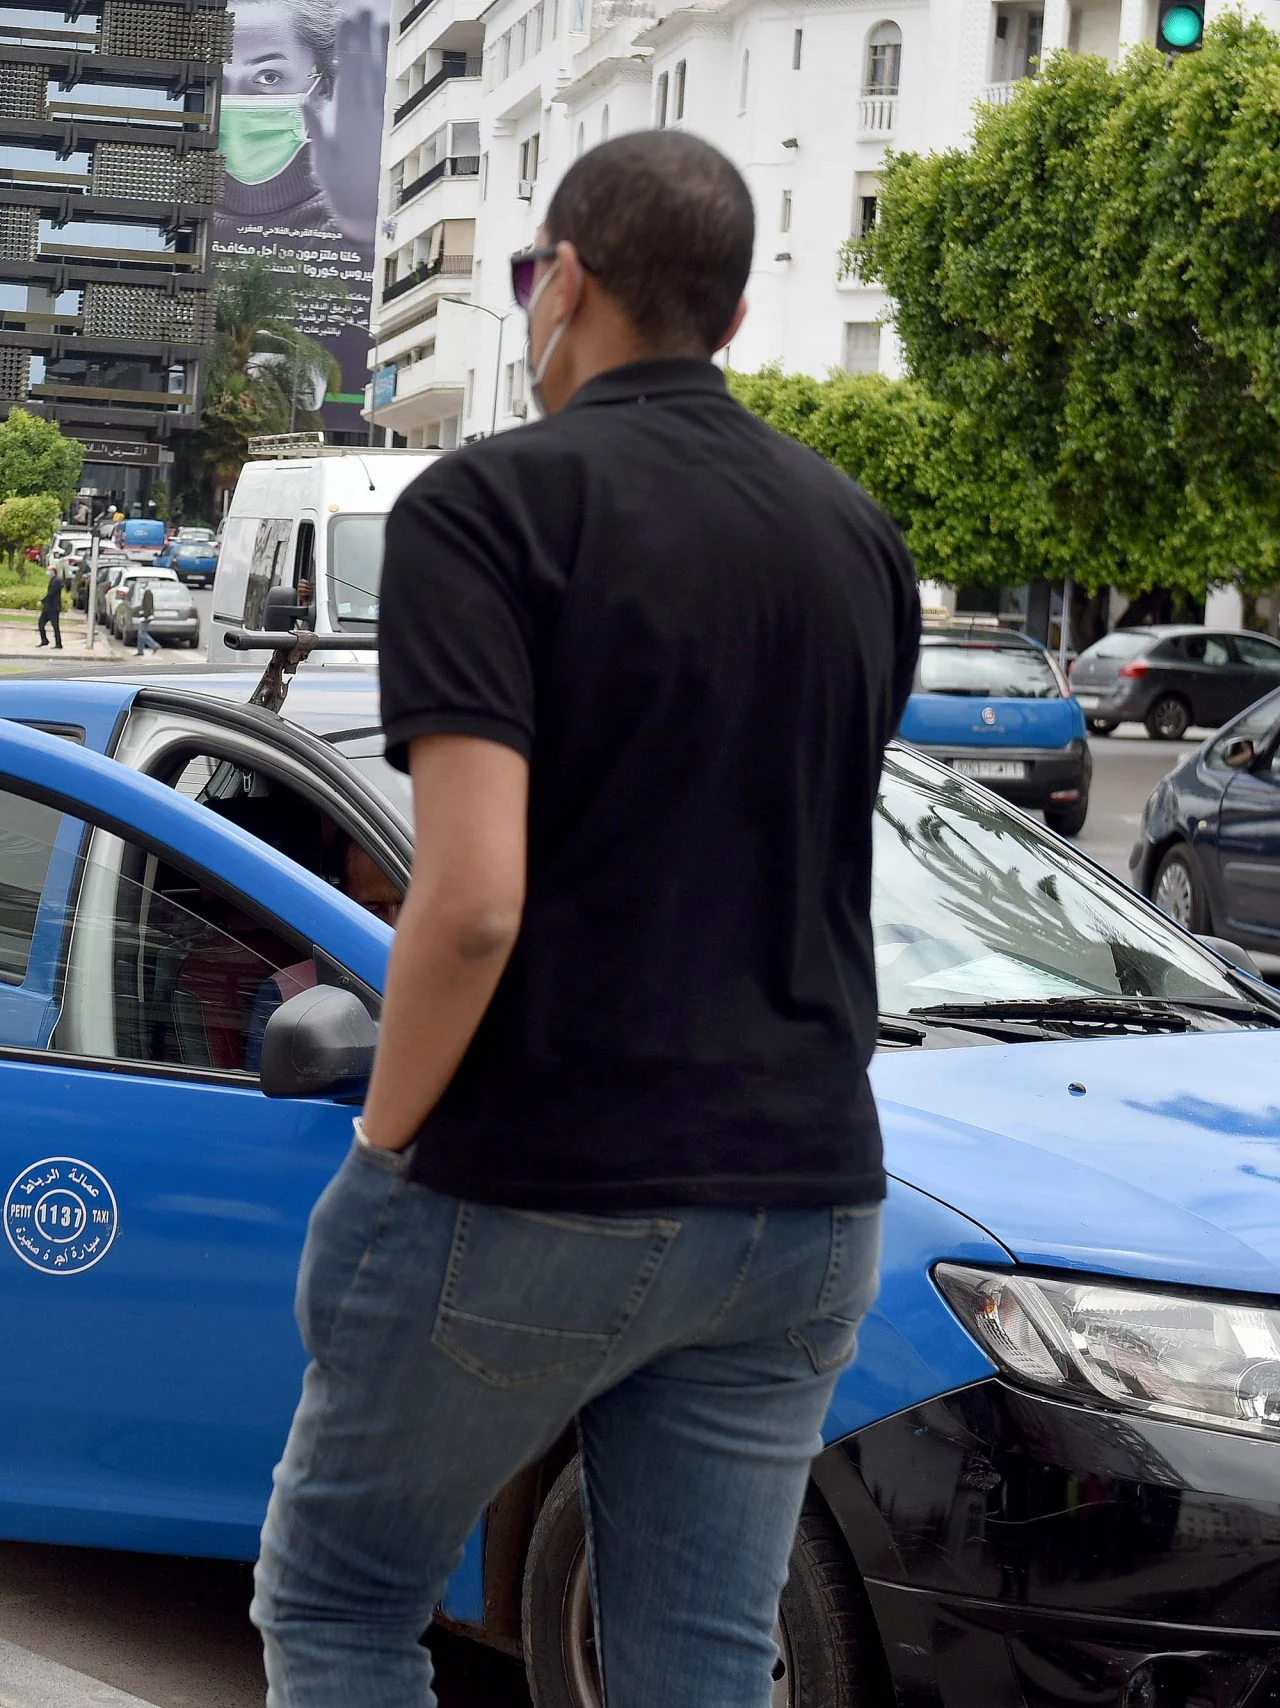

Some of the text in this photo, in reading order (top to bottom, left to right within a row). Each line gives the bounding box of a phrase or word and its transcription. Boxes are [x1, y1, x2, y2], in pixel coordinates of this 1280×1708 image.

[211, 241, 255, 255] مكافحة
[256, 243, 277, 257] أجل
[296, 249, 338, 262] ملتزمون
[339, 250, 361, 263] كلنا
[303, 264, 339, 279] كورونا
[20, 1168, 100, 1197] عمالة الرباط
[10, 1203, 109, 1228] PETIT 1137 TAXI
[15, 1227, 40, 1255] صغيرة
[71, 1236, 101, 1260] سيارة
